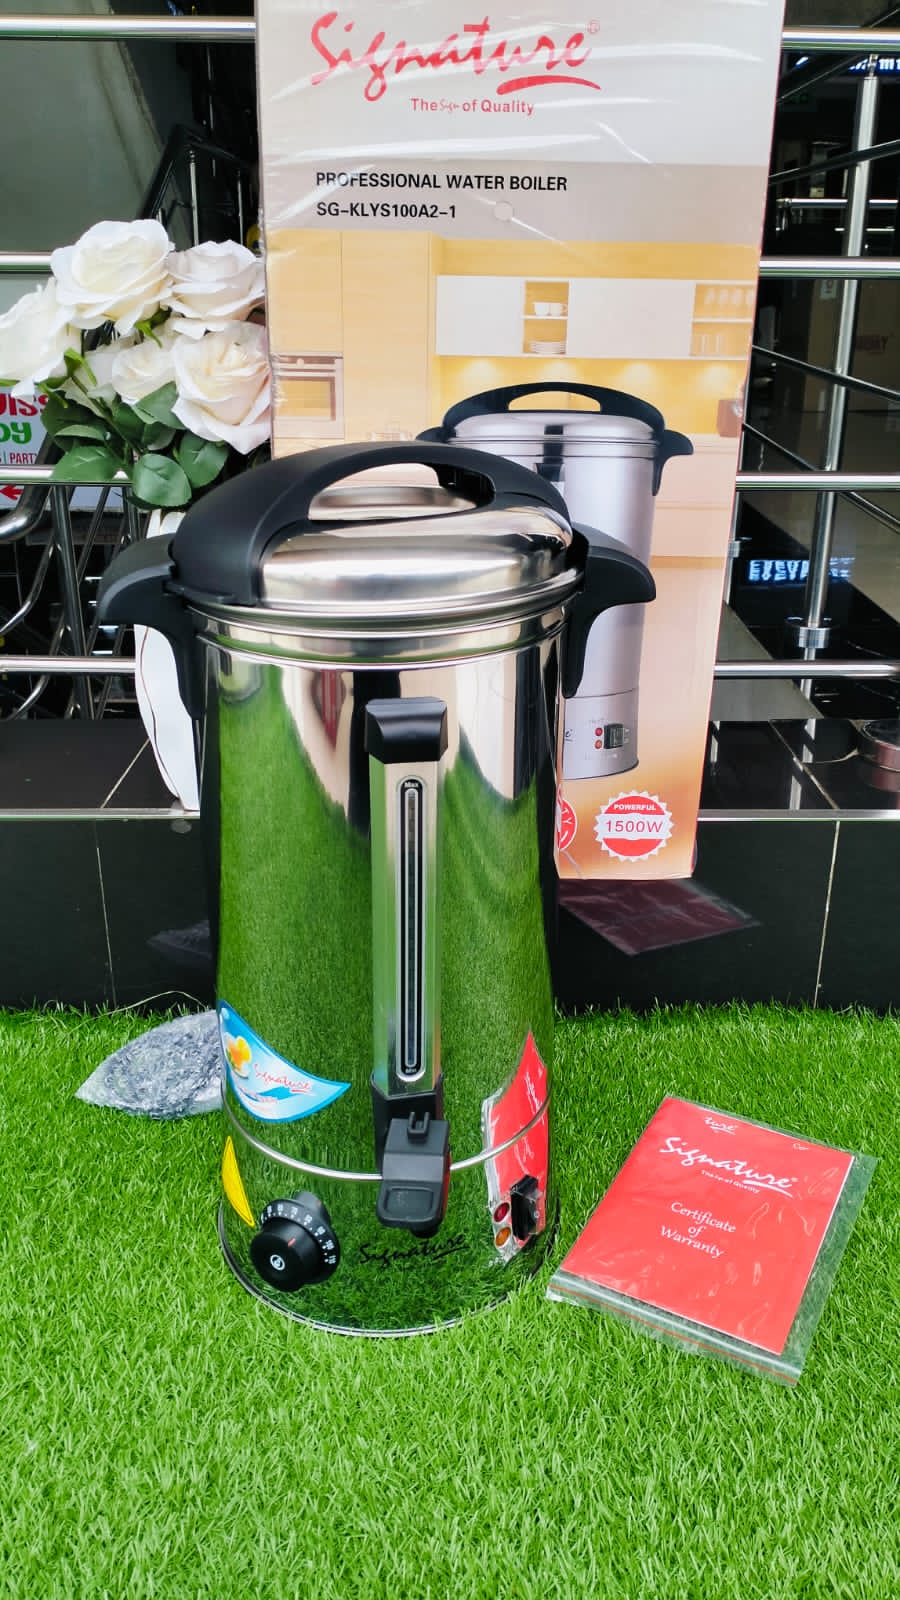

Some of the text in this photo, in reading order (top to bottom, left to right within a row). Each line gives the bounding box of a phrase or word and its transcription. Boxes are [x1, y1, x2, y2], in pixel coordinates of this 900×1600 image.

[310, 11, 602, 102] Signature
[411, 98, 438, 112] The
[462, 99, 478, 112] of
[481, 99, 534, 116] Quality
[316, 172, 568, 191] PROFESSIONAL WATER BOILER
[613, 803, 656, 811] POWERFUL
[606, 820, 663, 833] 1500W
[659, 1136, 794, 1197] Signature
[671, 1202, 736, 1232] Certificate
[688, 1226, 706, 1238] of
[661, 1225, 724, 1259] Warranty
